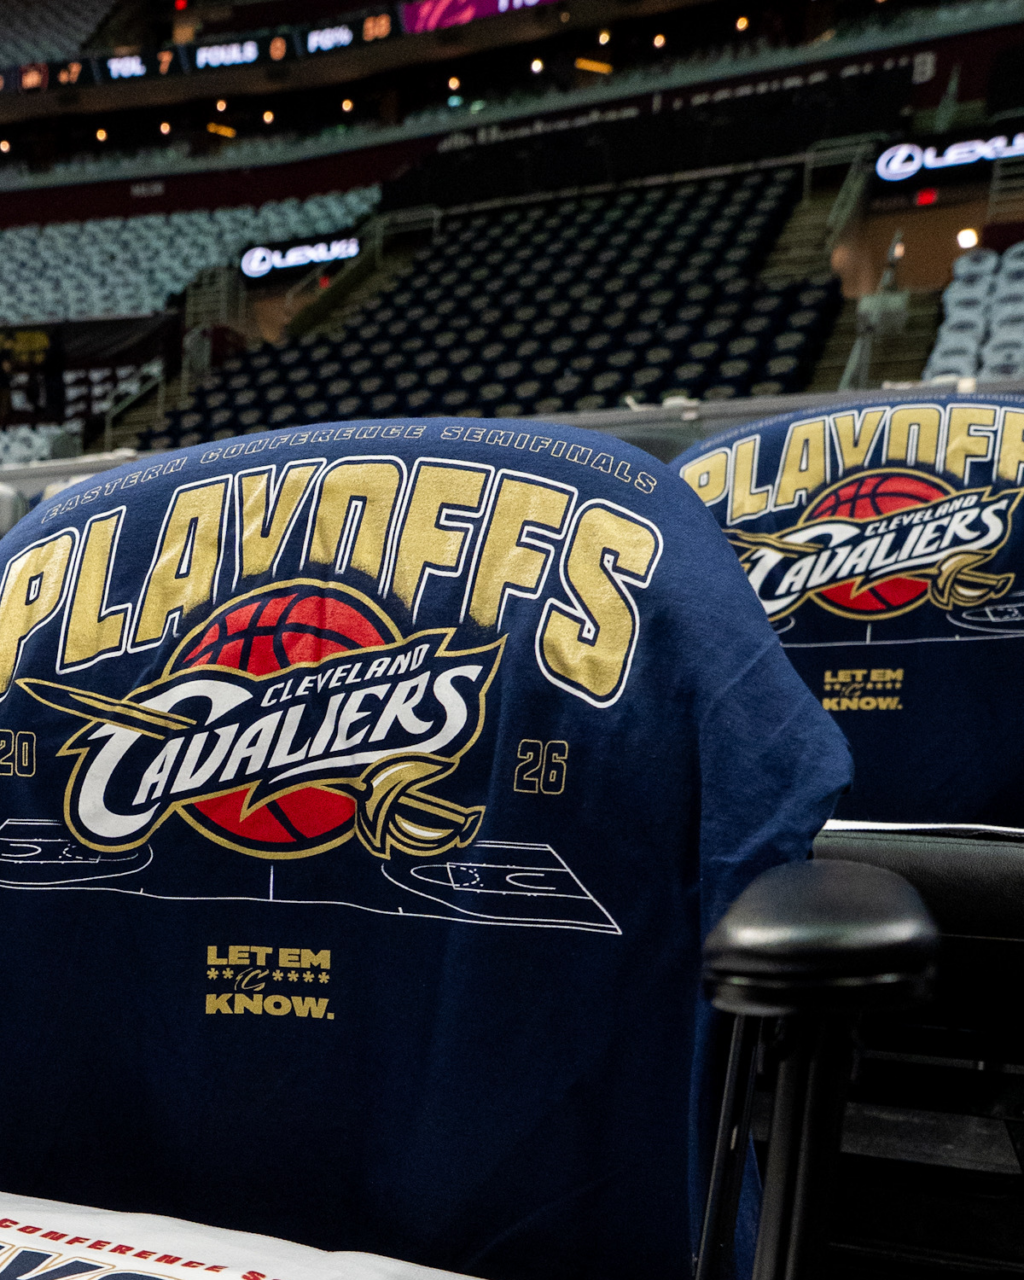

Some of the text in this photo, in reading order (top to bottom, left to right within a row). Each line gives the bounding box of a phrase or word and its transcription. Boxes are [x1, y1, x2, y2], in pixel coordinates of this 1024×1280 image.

[272, 238, 359, 268] LEXUS
[41, 456, 188, 524] EASTERN
[200, 424, 426, 464] CONFERENCE
[440, 426, 658, 494] SEMIFINALS
[865, 494, 979, 537] CLEVELAND
[264, 643, 430, 708] CLEVELAND
[824, 669, 904, 683] LET EM
[822, 697, 903, 711] KNOW.
[76, 664, 480, 838] CAVALIERS
[516, 739, 568, 794] 26
[207, 945, 331, 970] LET EM
[205, 993, 335, 1020] KNOW.
